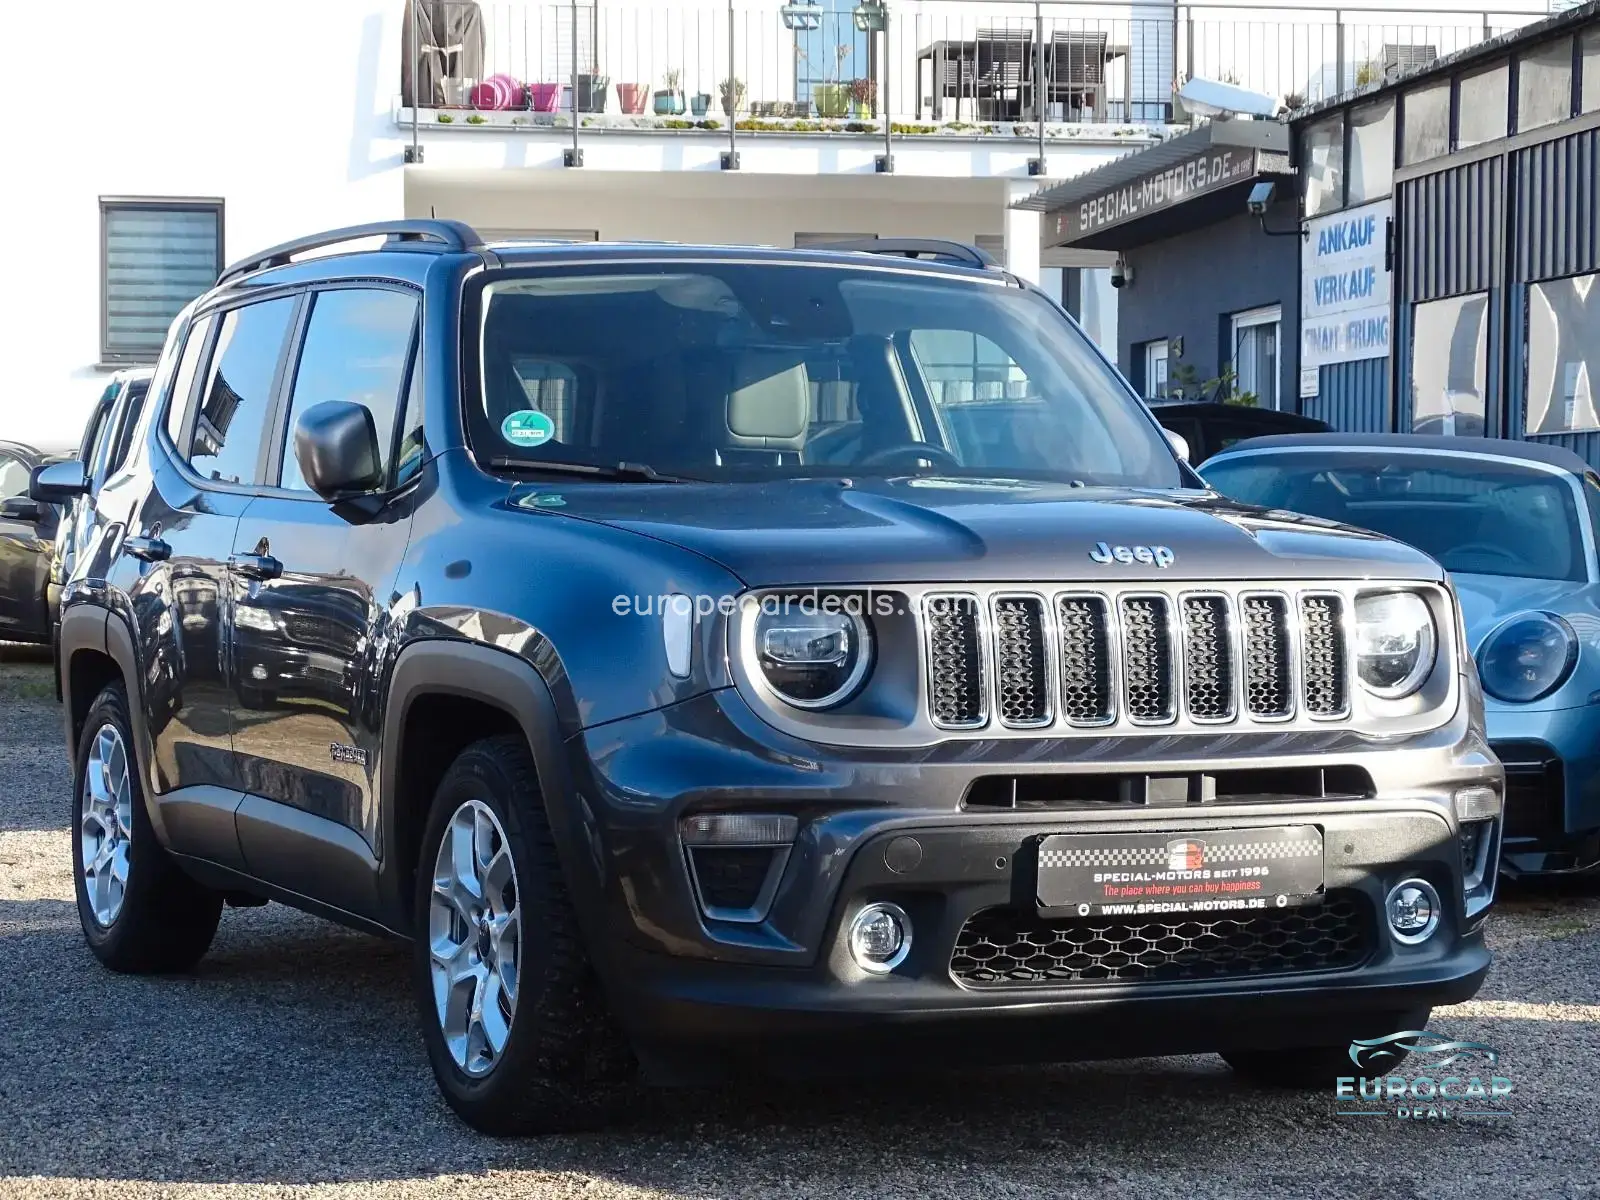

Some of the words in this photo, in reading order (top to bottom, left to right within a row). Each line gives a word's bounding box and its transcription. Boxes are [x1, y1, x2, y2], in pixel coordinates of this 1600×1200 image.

[1080, 152, 1232, 231] SPECIAL-MOTORS.DE
[1317, 214, 1376, 256] ANKAUF
[1314, 265, 1376, 307] VERKAUF
[1088, 541, 1175, 568] Jeep
[1093, 869, 1211, 883] SPECIAL-MOTORS
[1213, 869, 1238, 878] SEIT
[1240, 866, 1269, 877] 1996
[1104, 884, 1119, 896] The
[1121, 884, 1143, 898] place
[1145, 883, 1170, 895] where
[1173, 885, 1187, 895] you
[1188, 885, 1203, 893] can
[1205, 882, 1219, 893] buy
[1221, 880, 1261, 892] happiness
